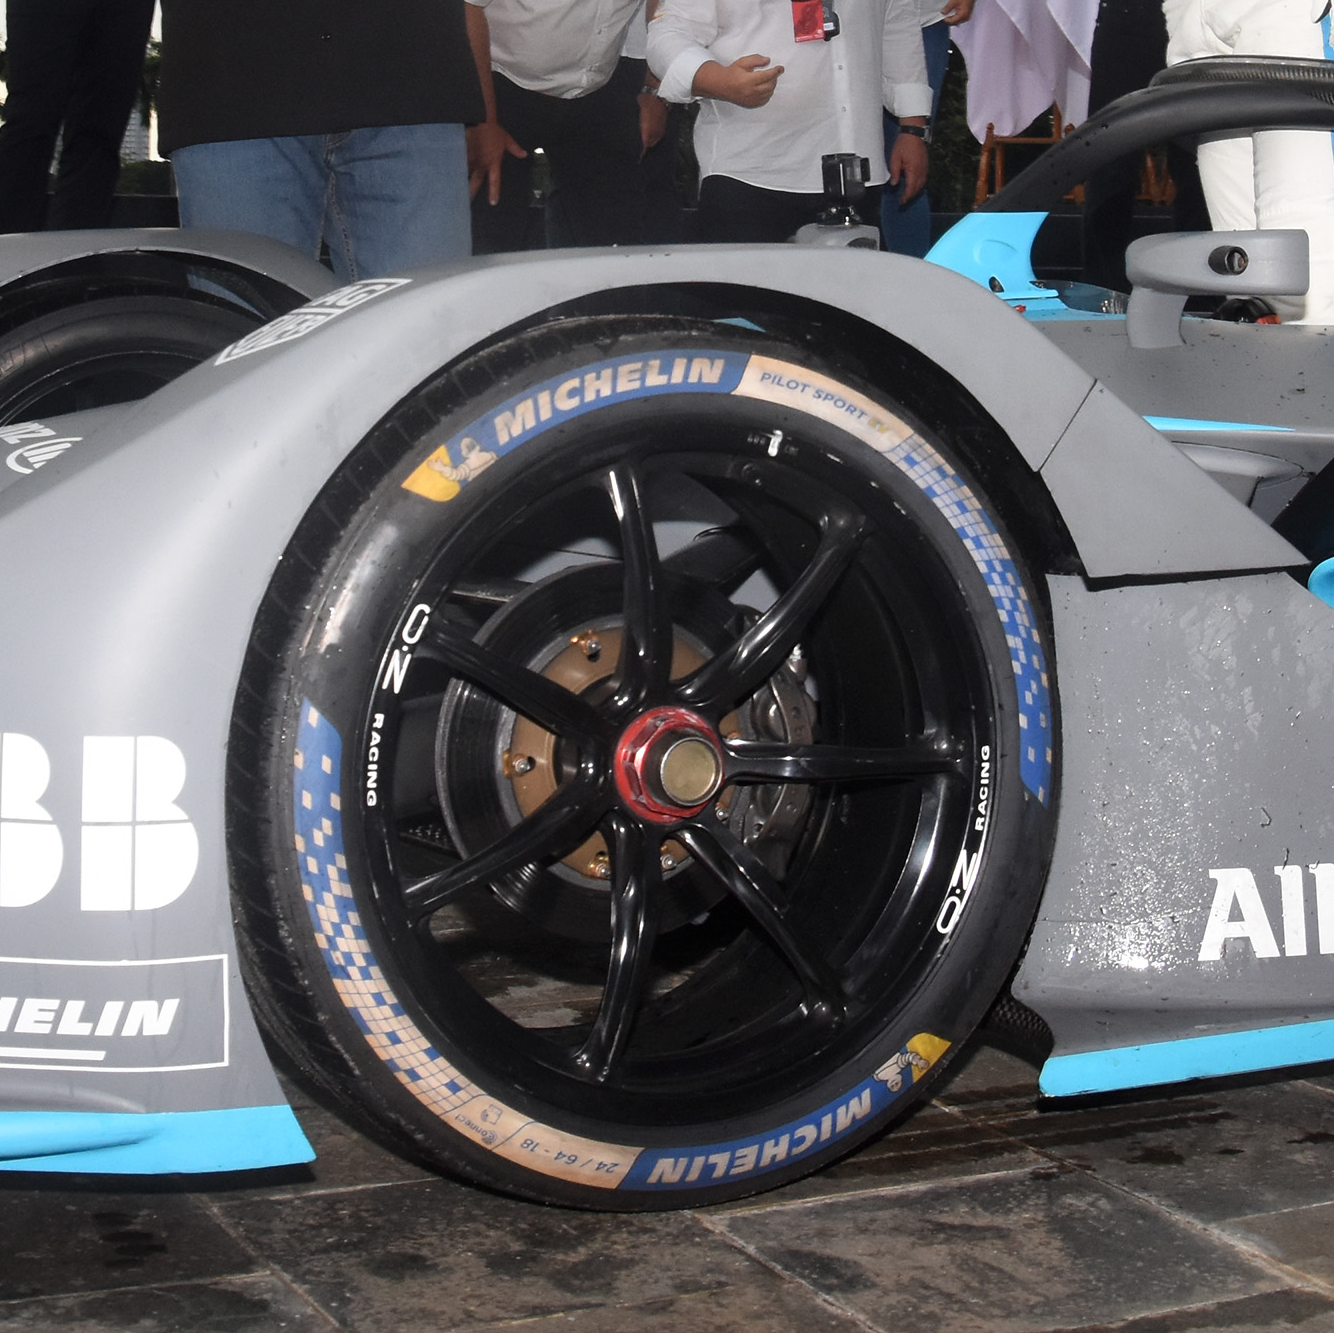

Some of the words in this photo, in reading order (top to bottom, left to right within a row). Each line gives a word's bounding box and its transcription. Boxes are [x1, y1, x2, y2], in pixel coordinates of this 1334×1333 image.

[494, 358, 725, 446] MICHELIN
[760, 372, 811, 394] PILOT
[812, 389, 869, 420] SPORT
[367, 713, 384, 807] RACING
[975, 745, 990, 831] RACING
[521, 1138, 540, 1152] 18
[554, 1151, 578, 1165] 64
[595, 1161, 619, 1173] 24
[646, 1088, 871, 1183] MICHELIN
